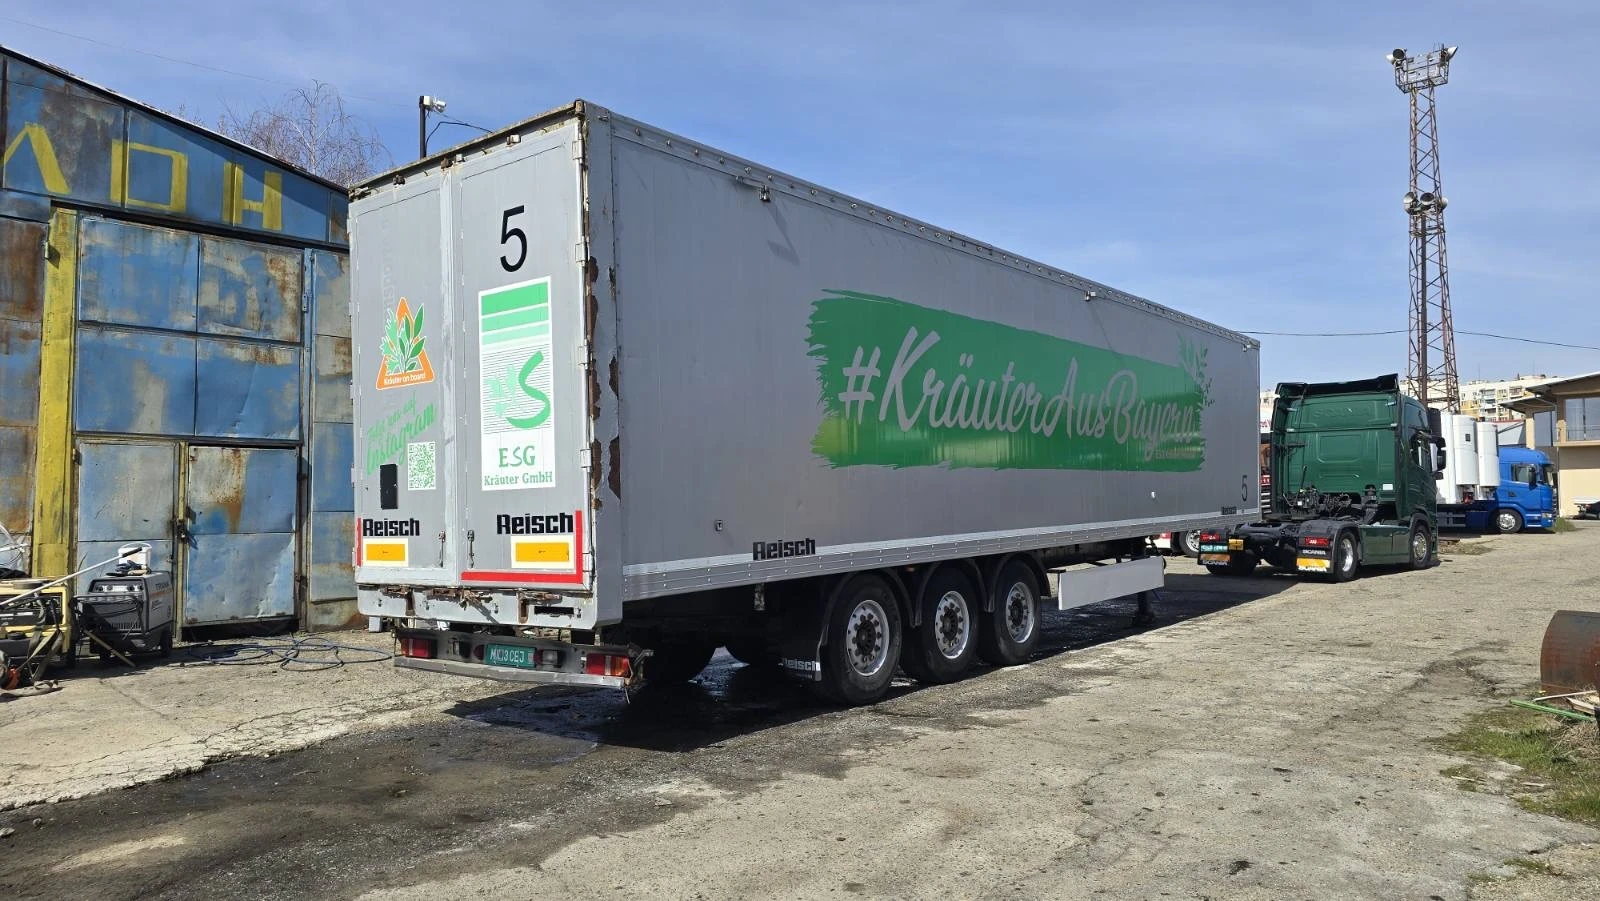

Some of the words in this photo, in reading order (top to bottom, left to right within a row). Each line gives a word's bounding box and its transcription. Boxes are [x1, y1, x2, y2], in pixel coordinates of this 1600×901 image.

[499, 205, 528, 273] 5
[498, 445, 536, 468] ESG
[484, 473, 520, 487] Kräuter
[522, 471, 553, 484] GmbH
[1241, 474, 1248, 502] 5
[363, 518, 420, 536] Reisch
[497, 513, 574, 534] Reisch
[753, 538, 816, 561] Reisch
